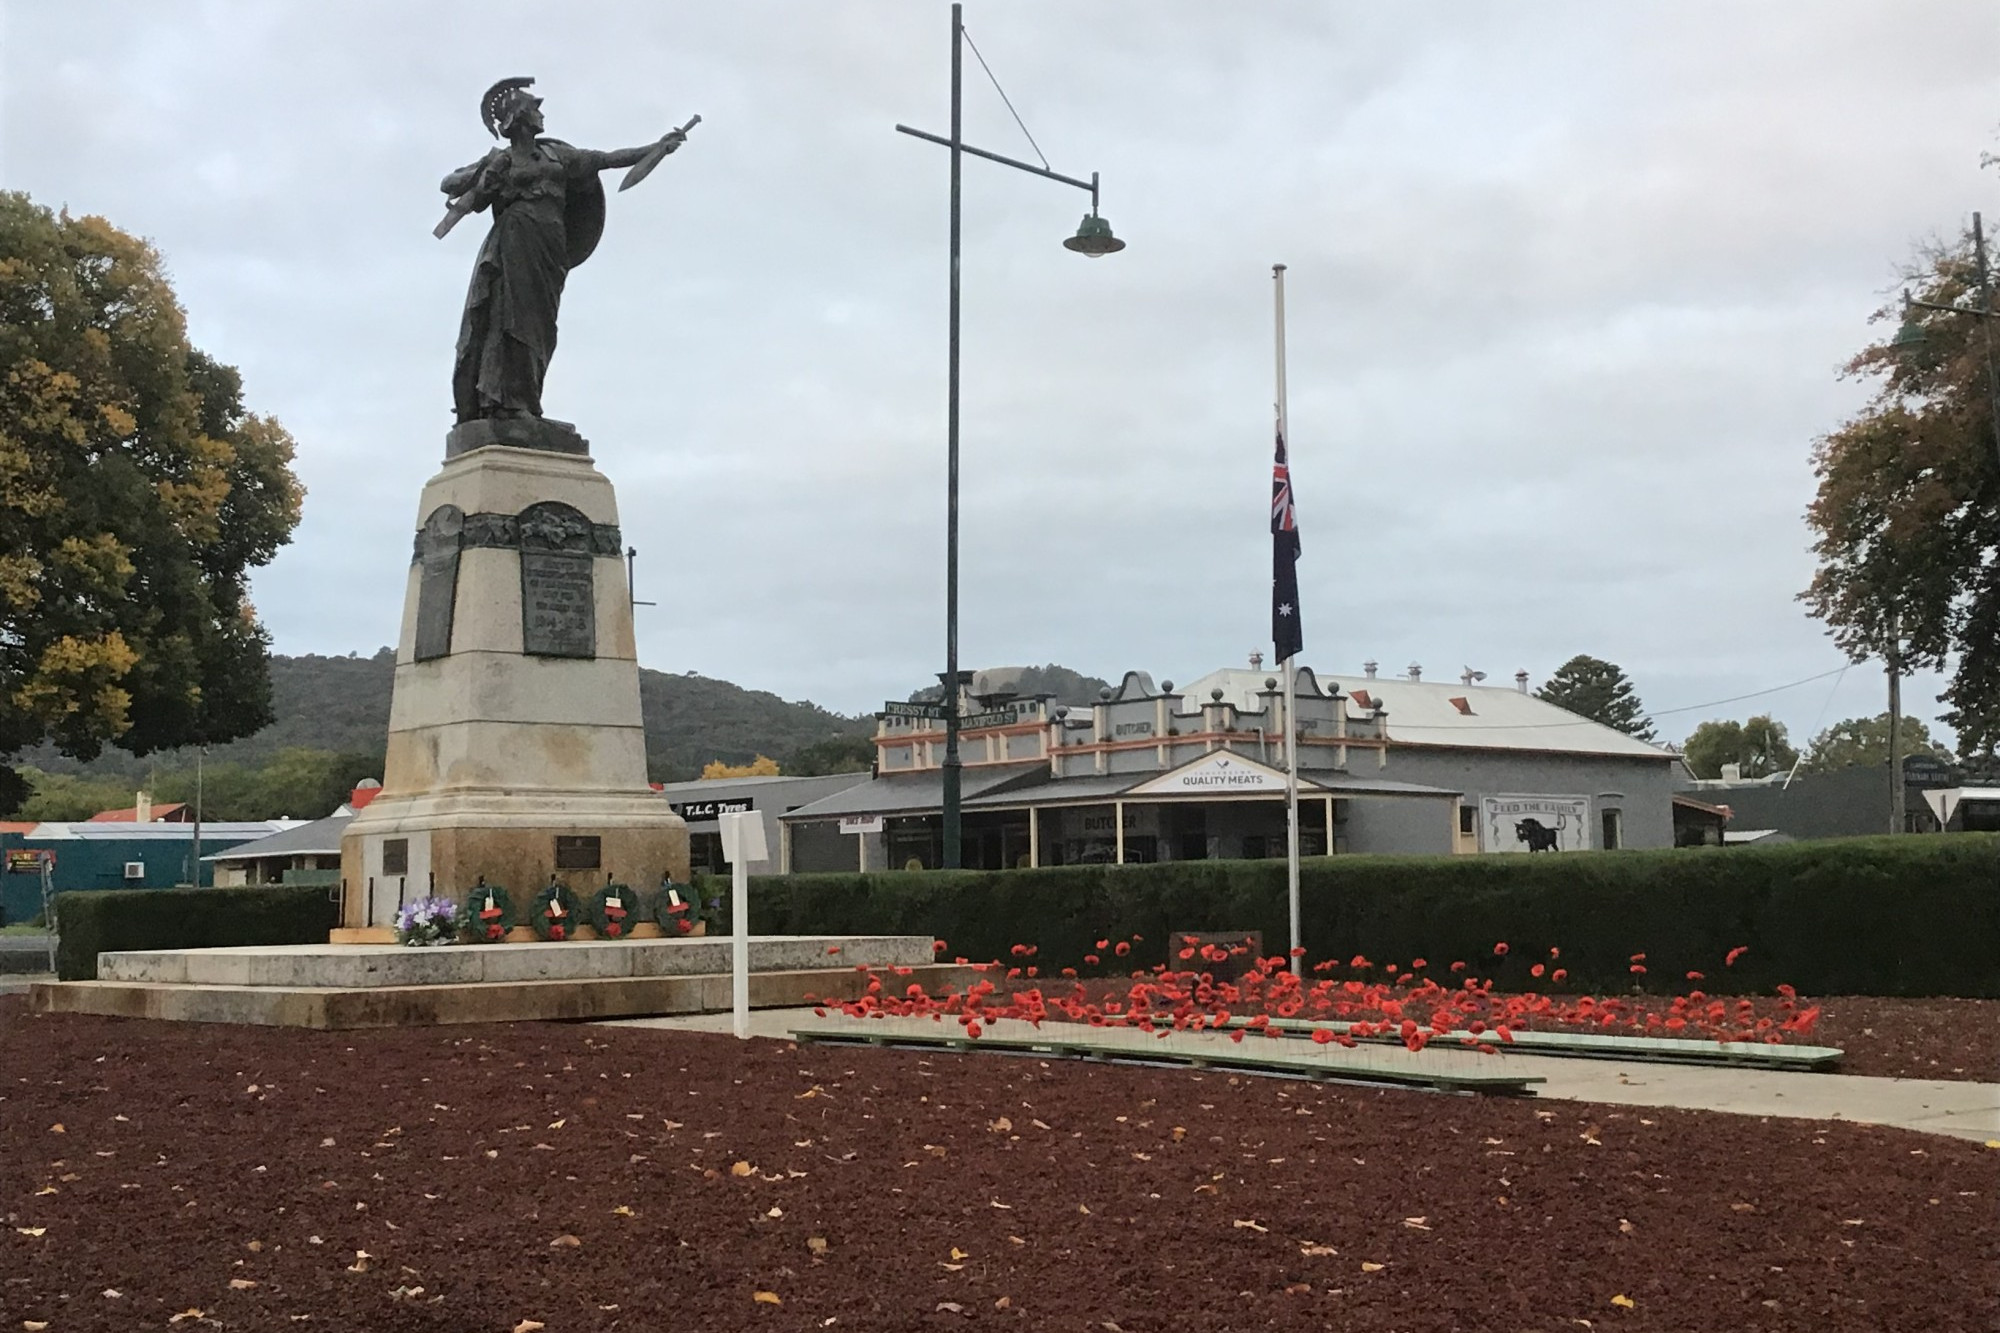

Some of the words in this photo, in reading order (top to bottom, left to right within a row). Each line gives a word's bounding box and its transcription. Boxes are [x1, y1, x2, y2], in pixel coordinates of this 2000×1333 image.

[887, 702, 926, 716] CRESSY
[961, 714, 1003, 728] MANIFOLD
[1004, 713, 1015, 724] ST
[1182, 776, 1226, 786] QUALITY
[1228, 775, 1264, 784] MEATS
[685, 804, 714, 816] T.L.C.
[718, 803, 747, 813] Tyres
[1494, 804, 1520, 812] FEED
[1524, 803, 1540, 811] THE
[1085, 814, 1137, 830] BUTCER
